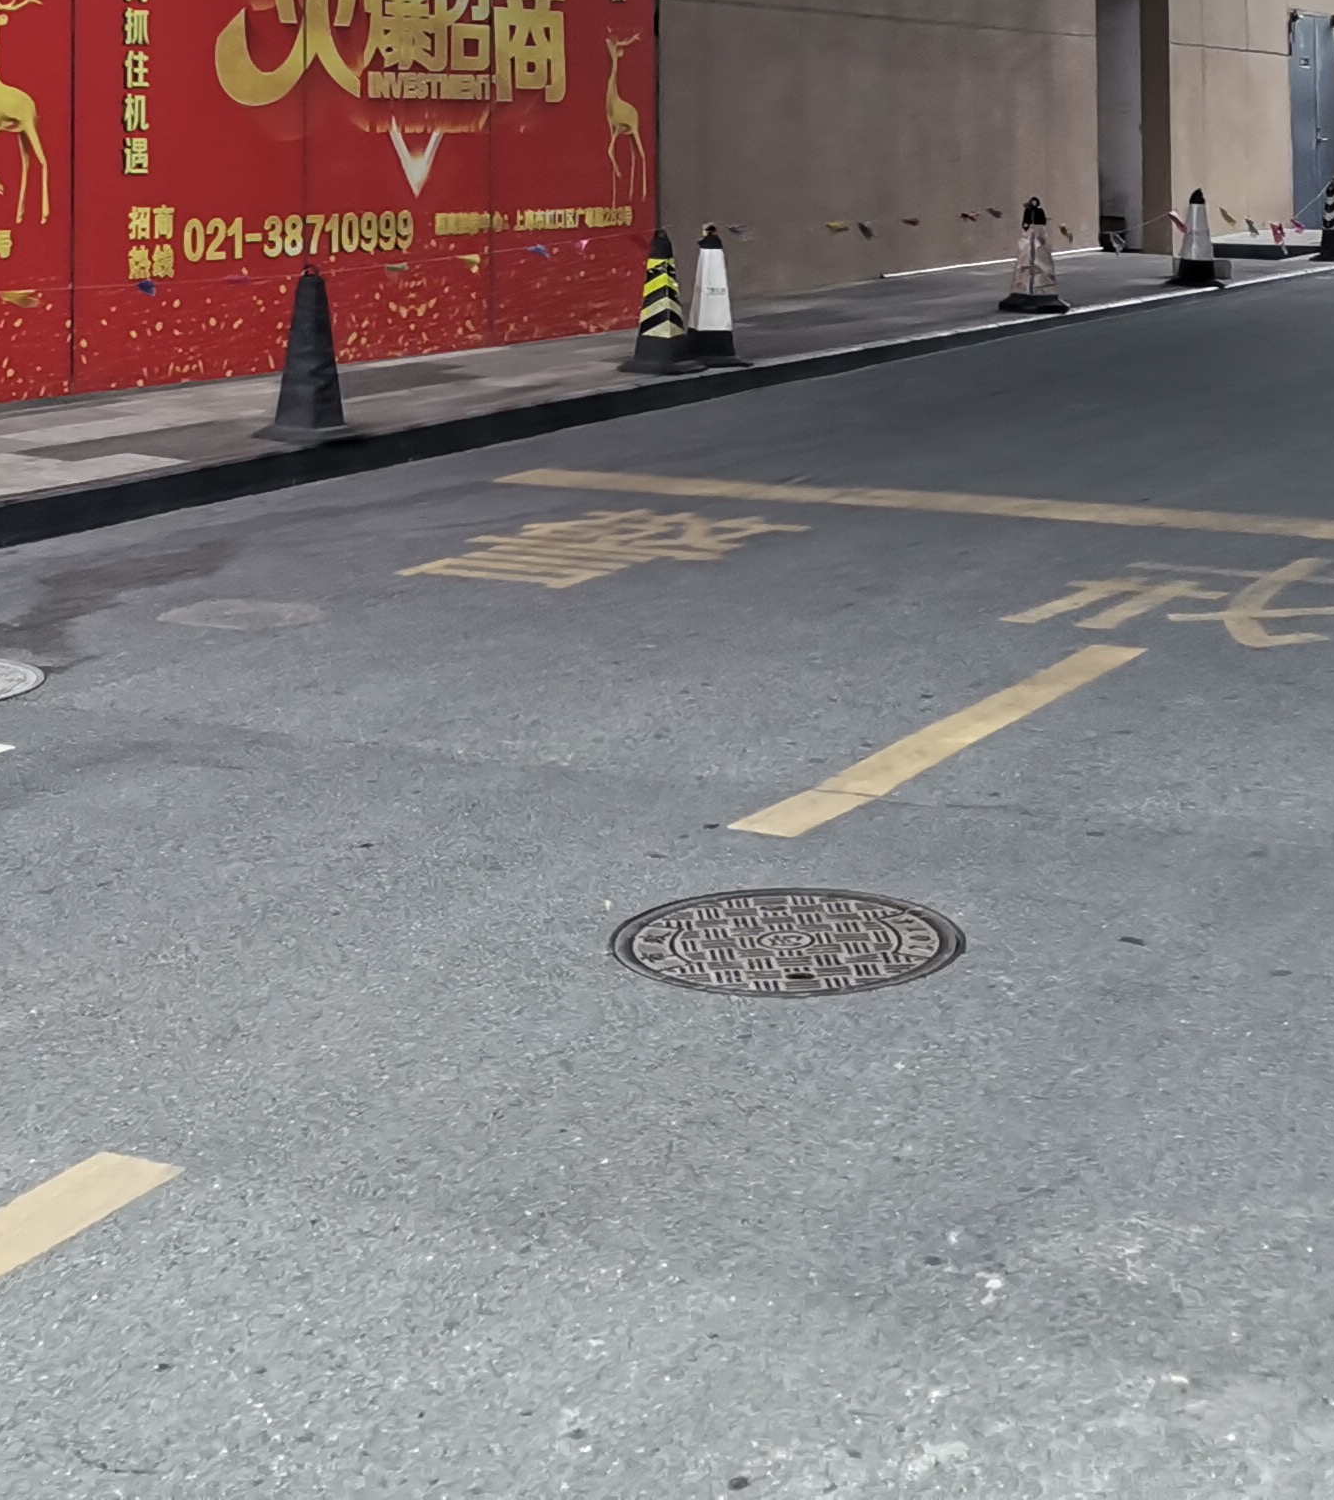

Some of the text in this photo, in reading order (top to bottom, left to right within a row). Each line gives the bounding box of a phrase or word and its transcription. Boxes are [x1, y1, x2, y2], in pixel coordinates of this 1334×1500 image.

[127, 204, 175, 240] 招商
[183, 209, 414, 263] 021-38710999
[127, 244, 175, 280] 热线
